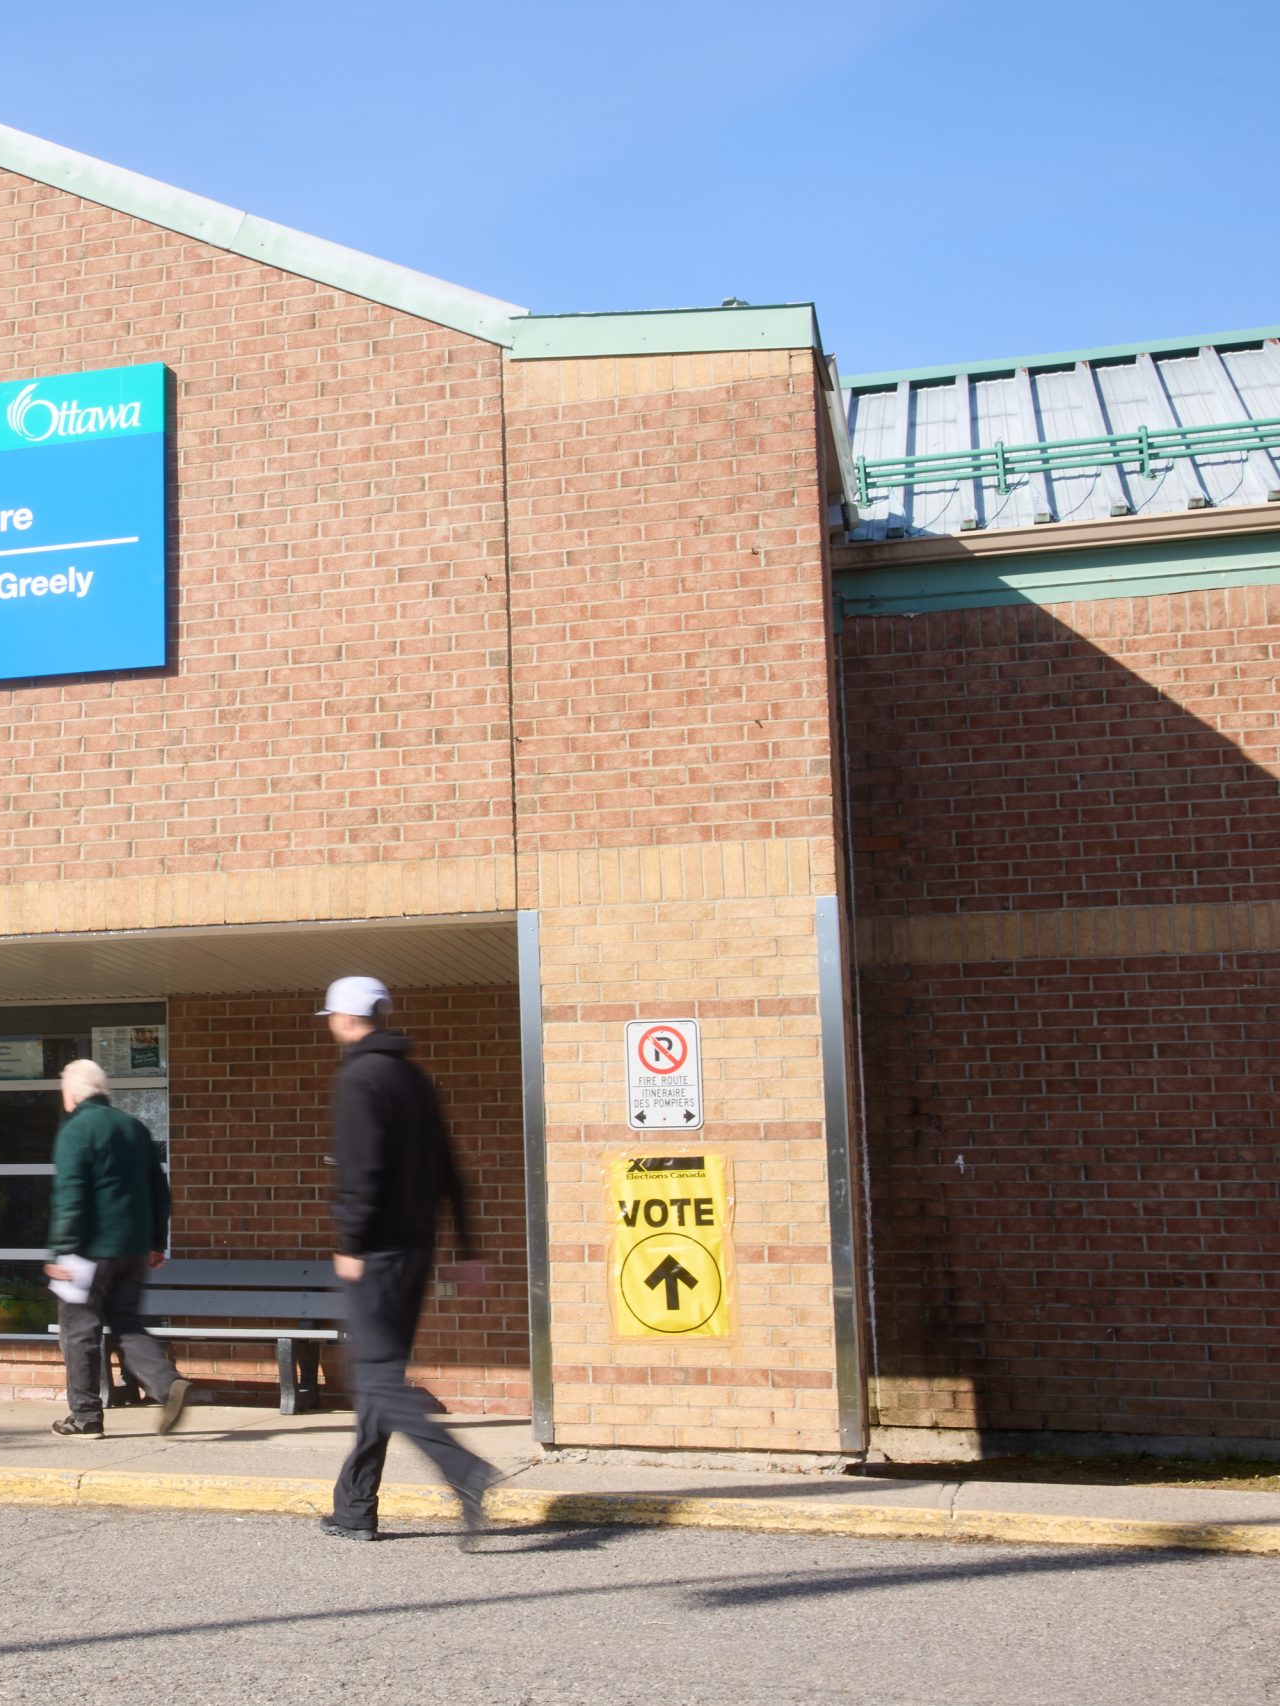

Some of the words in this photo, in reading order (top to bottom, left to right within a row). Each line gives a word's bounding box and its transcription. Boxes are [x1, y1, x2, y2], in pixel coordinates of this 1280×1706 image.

[8, 384, 141, 441] Ottawa
[639, 1076, 656, 1085] FIRE
[661, 1075, 688, 1085] ROUTE
[634, 1099, 650, 1108] DES
[654, 1098, 695, 1108] POMPIERS
[626, 1172, 669, 1180] Elections
[618, 1198, 714, 1228] VOTE
